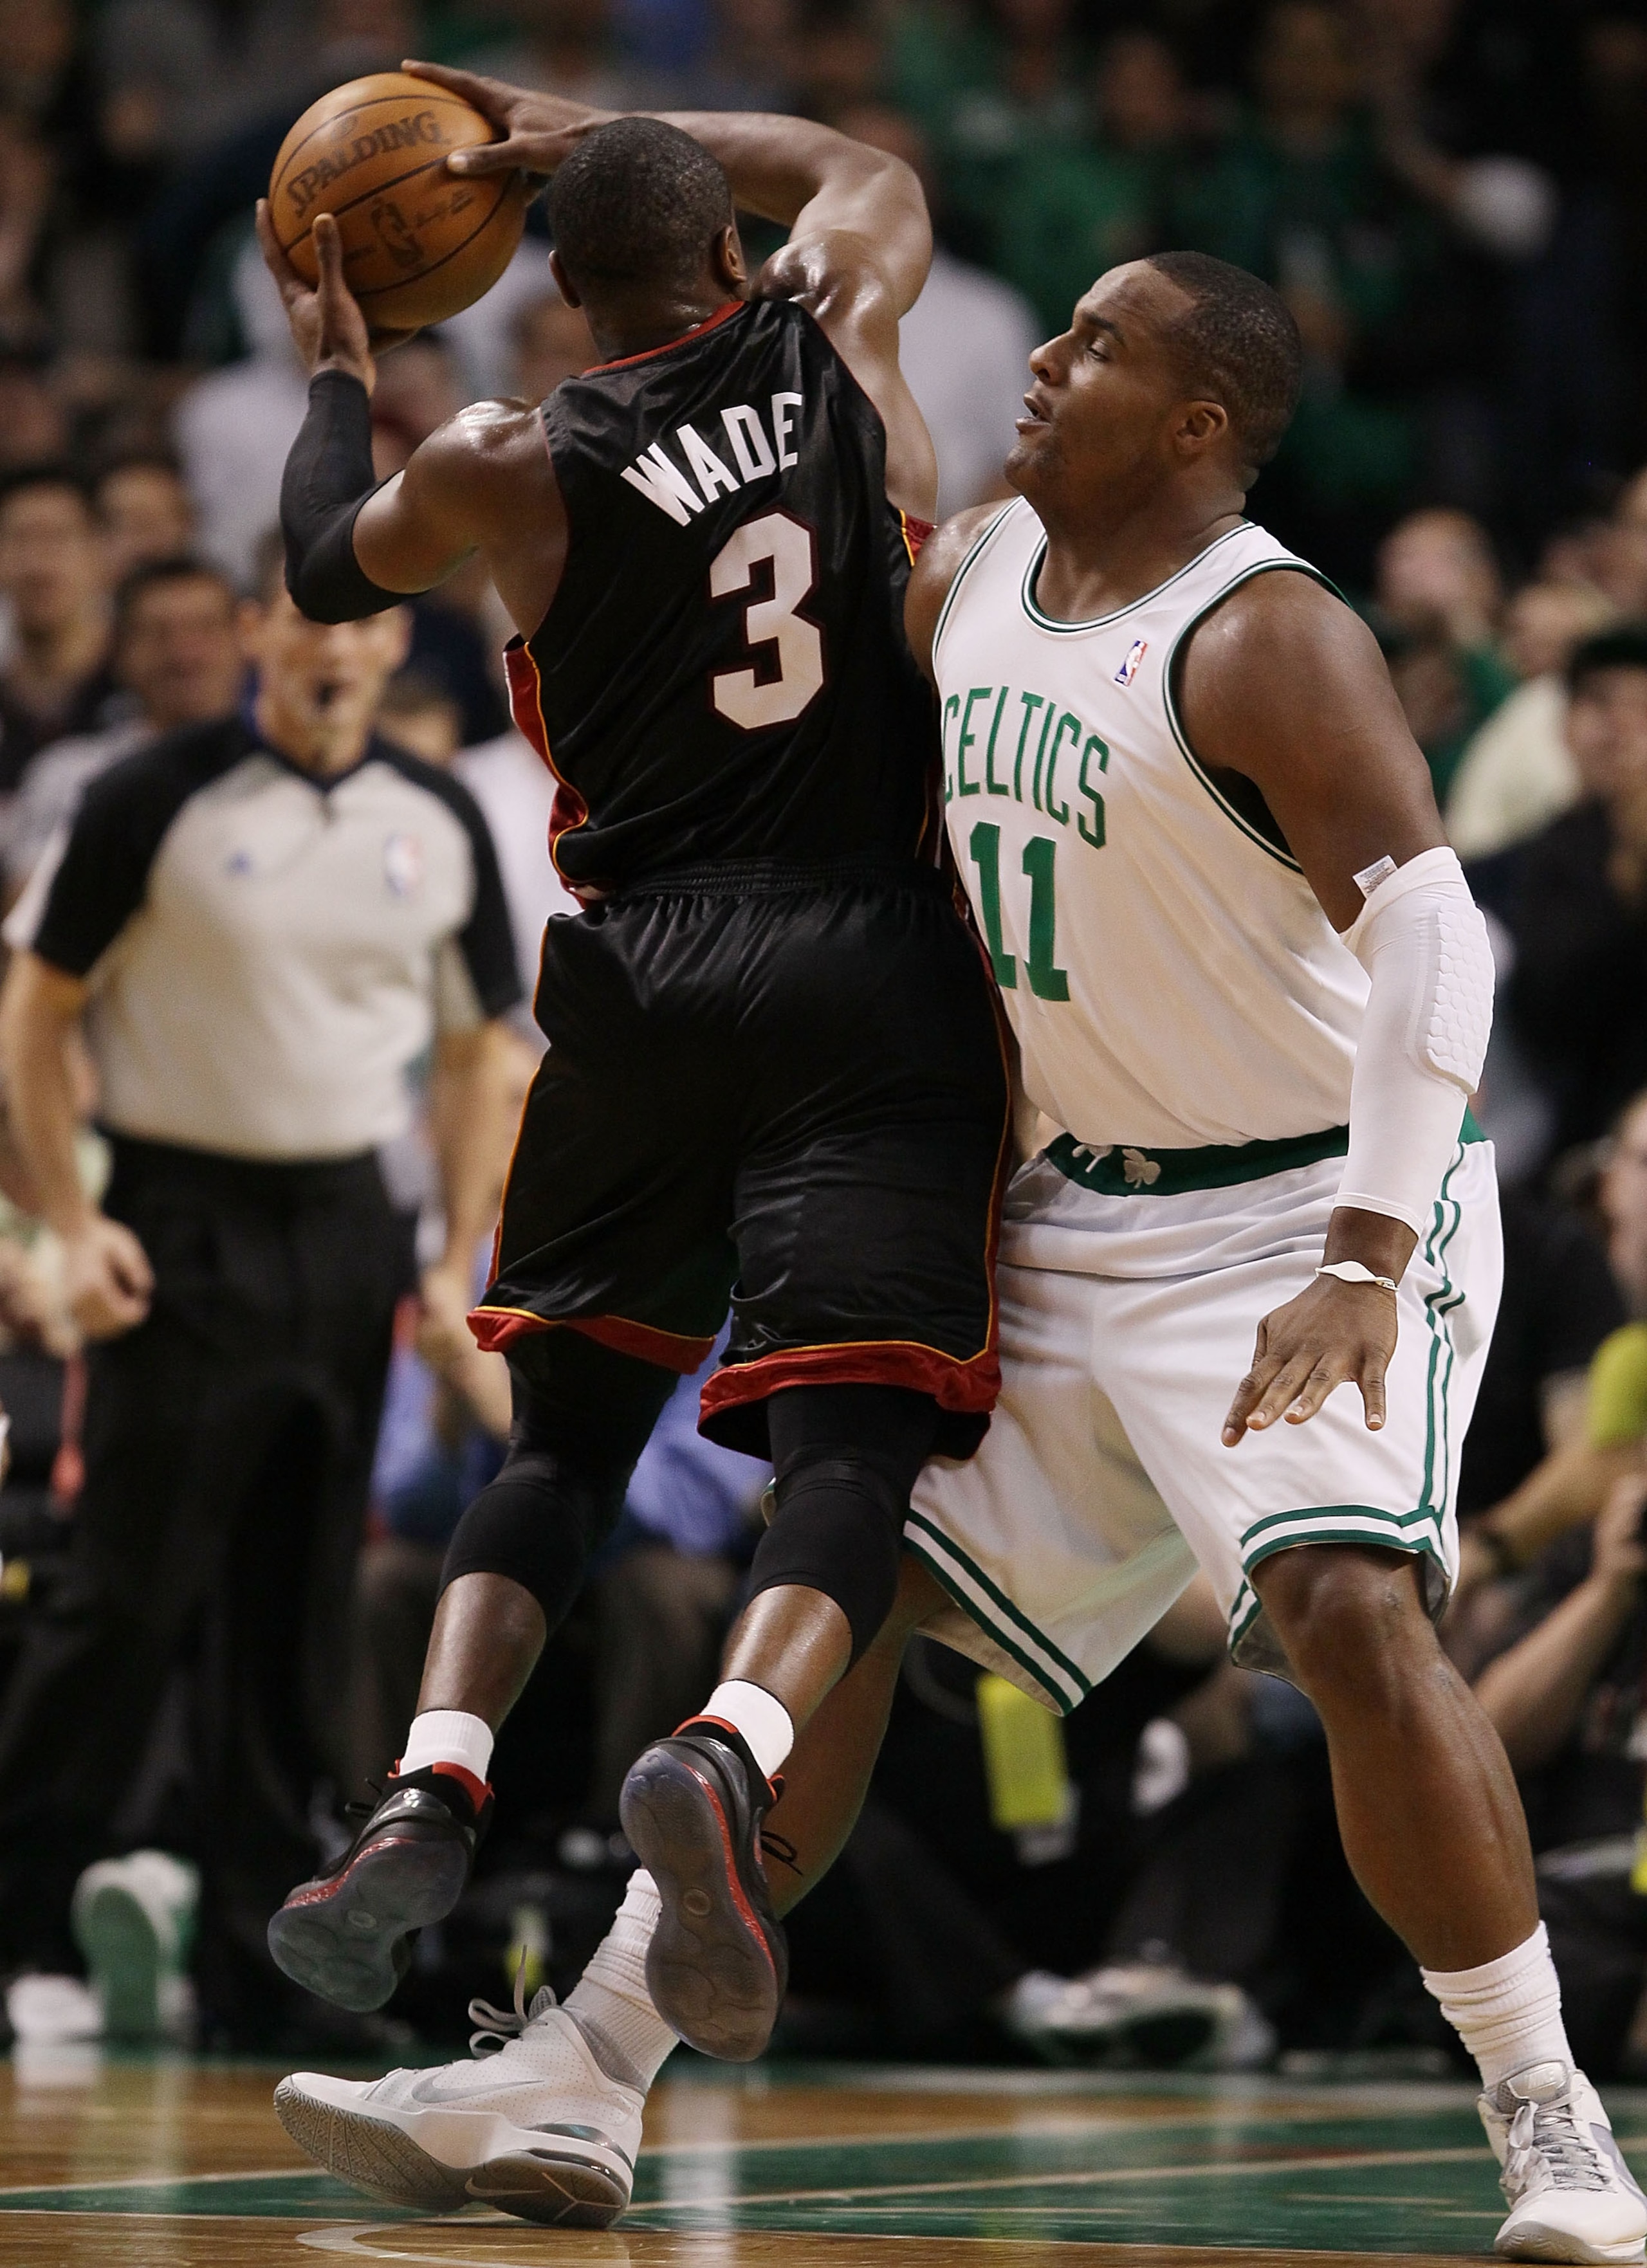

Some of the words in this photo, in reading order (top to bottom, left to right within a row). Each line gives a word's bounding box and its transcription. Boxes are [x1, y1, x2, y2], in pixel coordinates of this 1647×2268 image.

[287, 111, 445, 218] SPALDING
[620, 392, 802, 527] WADE
[710, 512, 824, 729] 3
[943, 686, 1110, 849] CELTICS
[970, 821, 1070, 1001] 11
